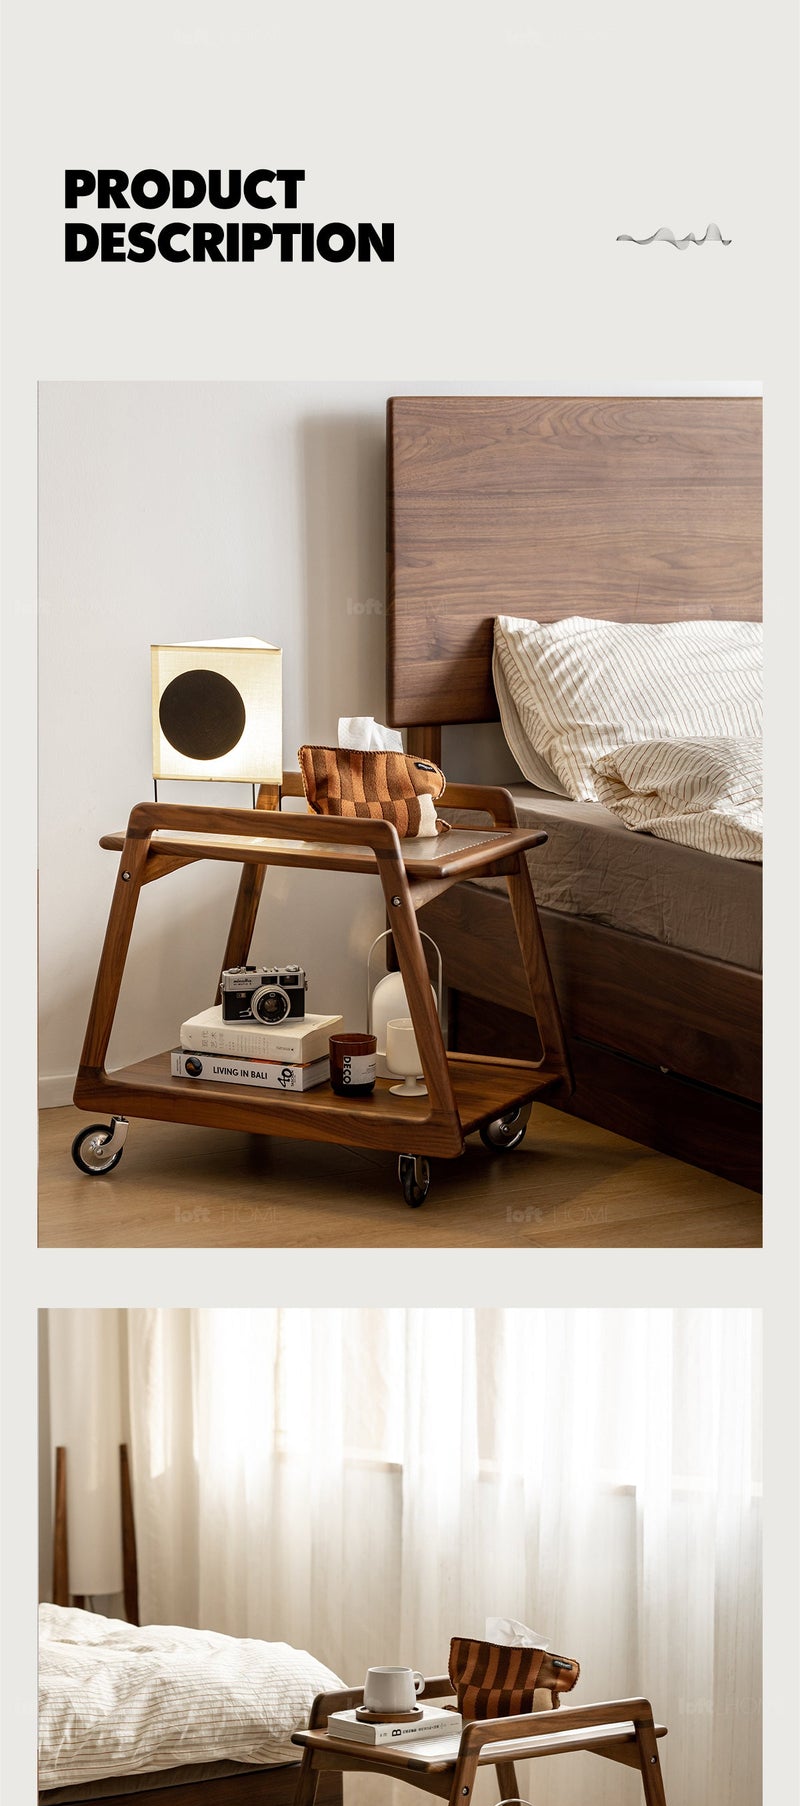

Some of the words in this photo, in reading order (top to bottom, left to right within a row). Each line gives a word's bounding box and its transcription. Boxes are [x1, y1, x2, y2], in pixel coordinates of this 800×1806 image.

[213, 1066, 239, 1077] LIVING
[240, 1069, 249, 1078] IN
[251, 1071, 268, 1080] BALI
[343, 1056, 351, 1084] DECO
[392, 1729, 401, 1737] B
